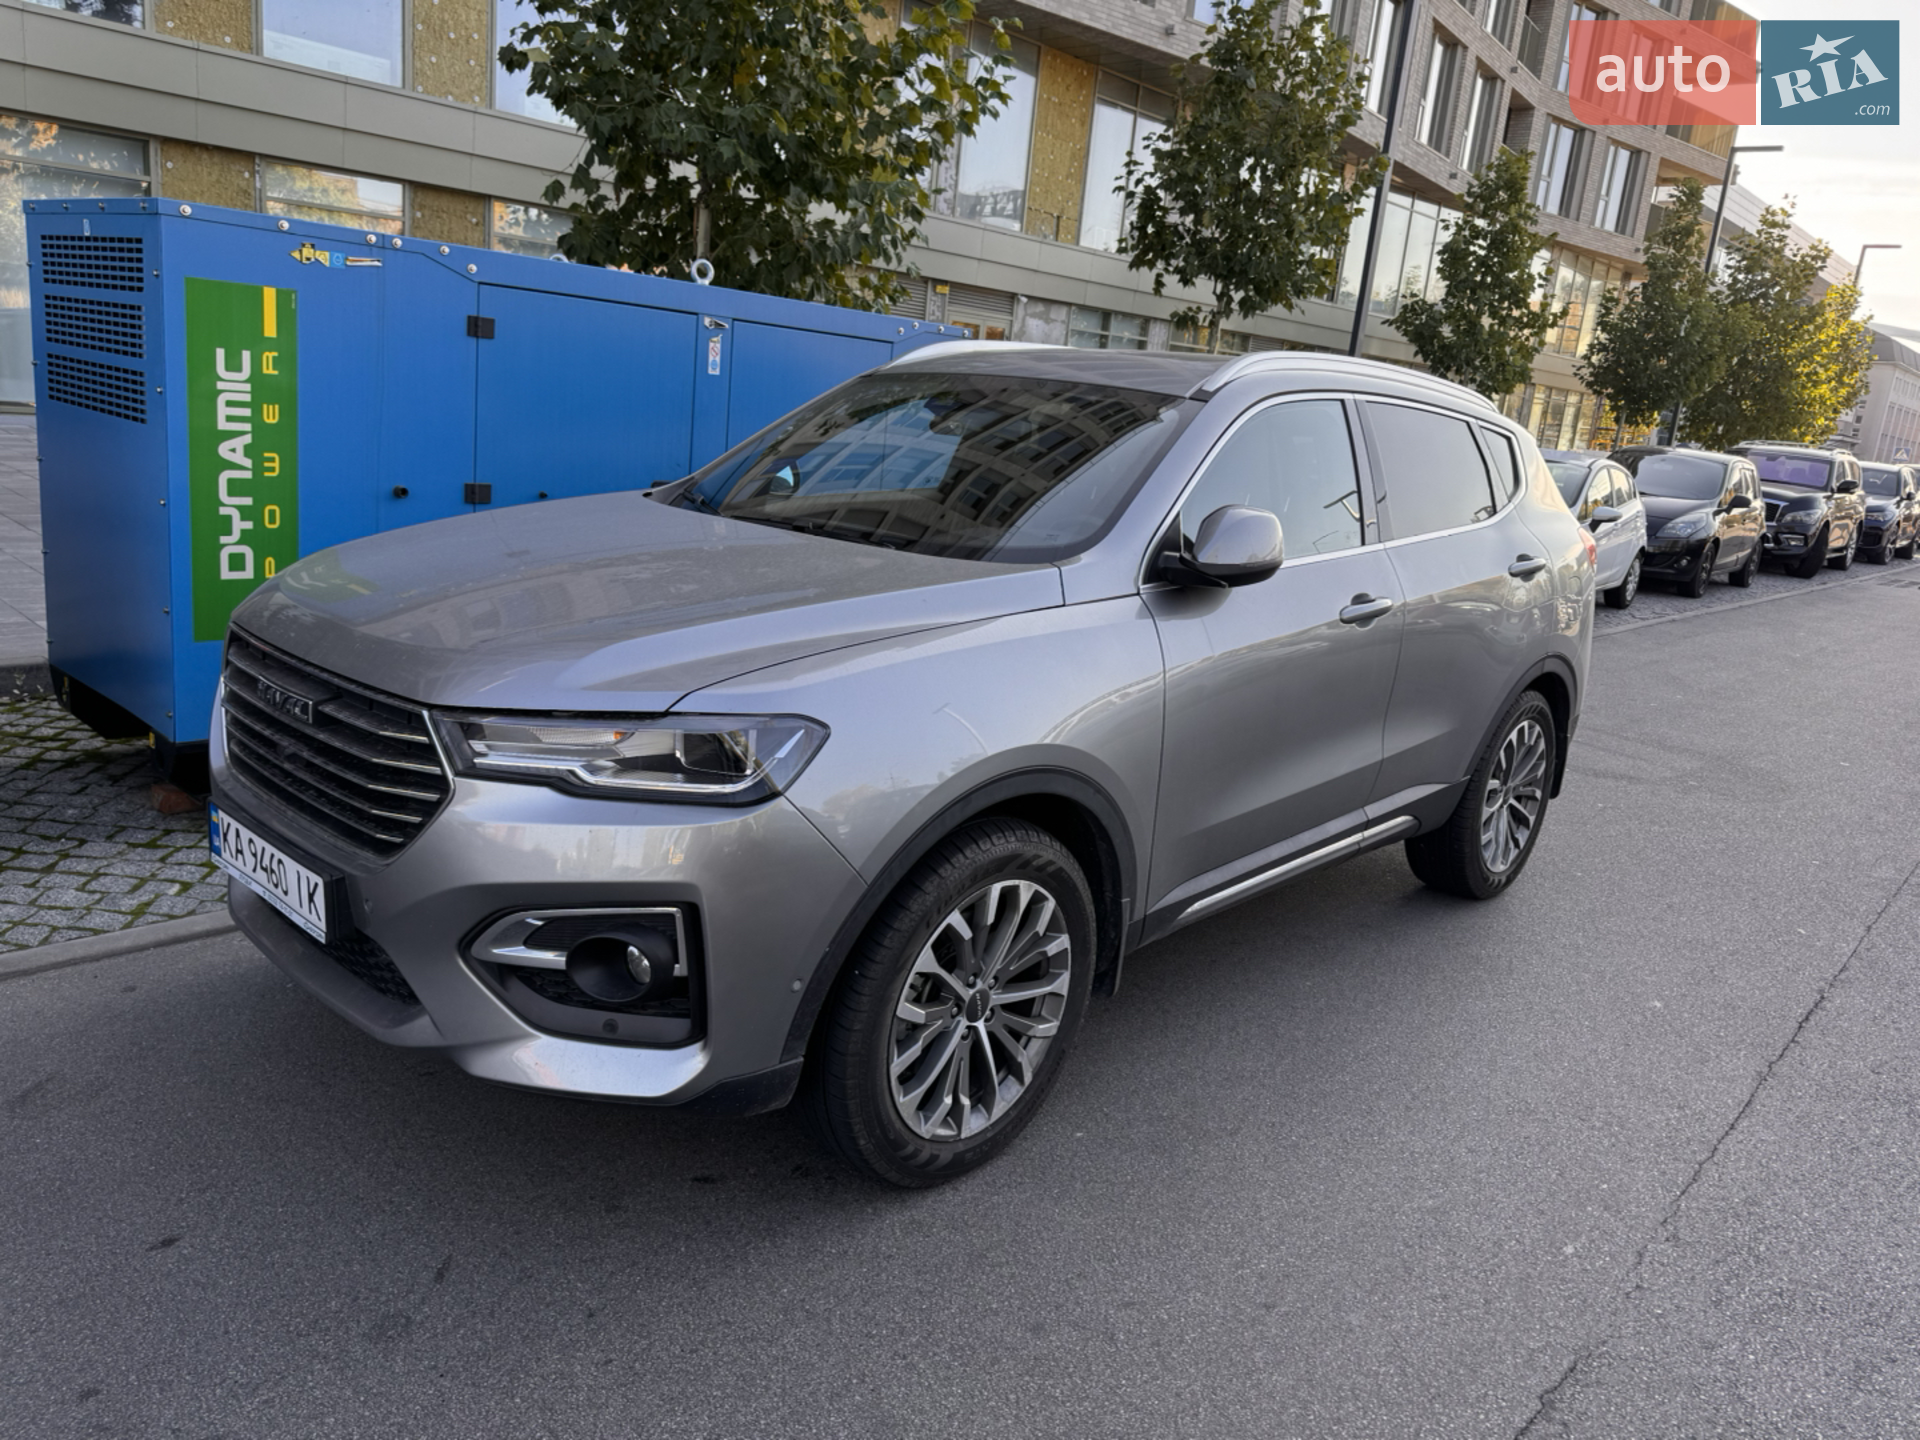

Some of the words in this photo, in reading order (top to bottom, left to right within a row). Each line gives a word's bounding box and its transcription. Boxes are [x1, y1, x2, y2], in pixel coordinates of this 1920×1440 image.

[216, 347, 254, 580] DYNAMIC
[262, 351, 281, 579] POWER
[221, 817, 247, 867] KA
[248, 837, 289, 897] 9460
[296, 870, 322, 922] IK
